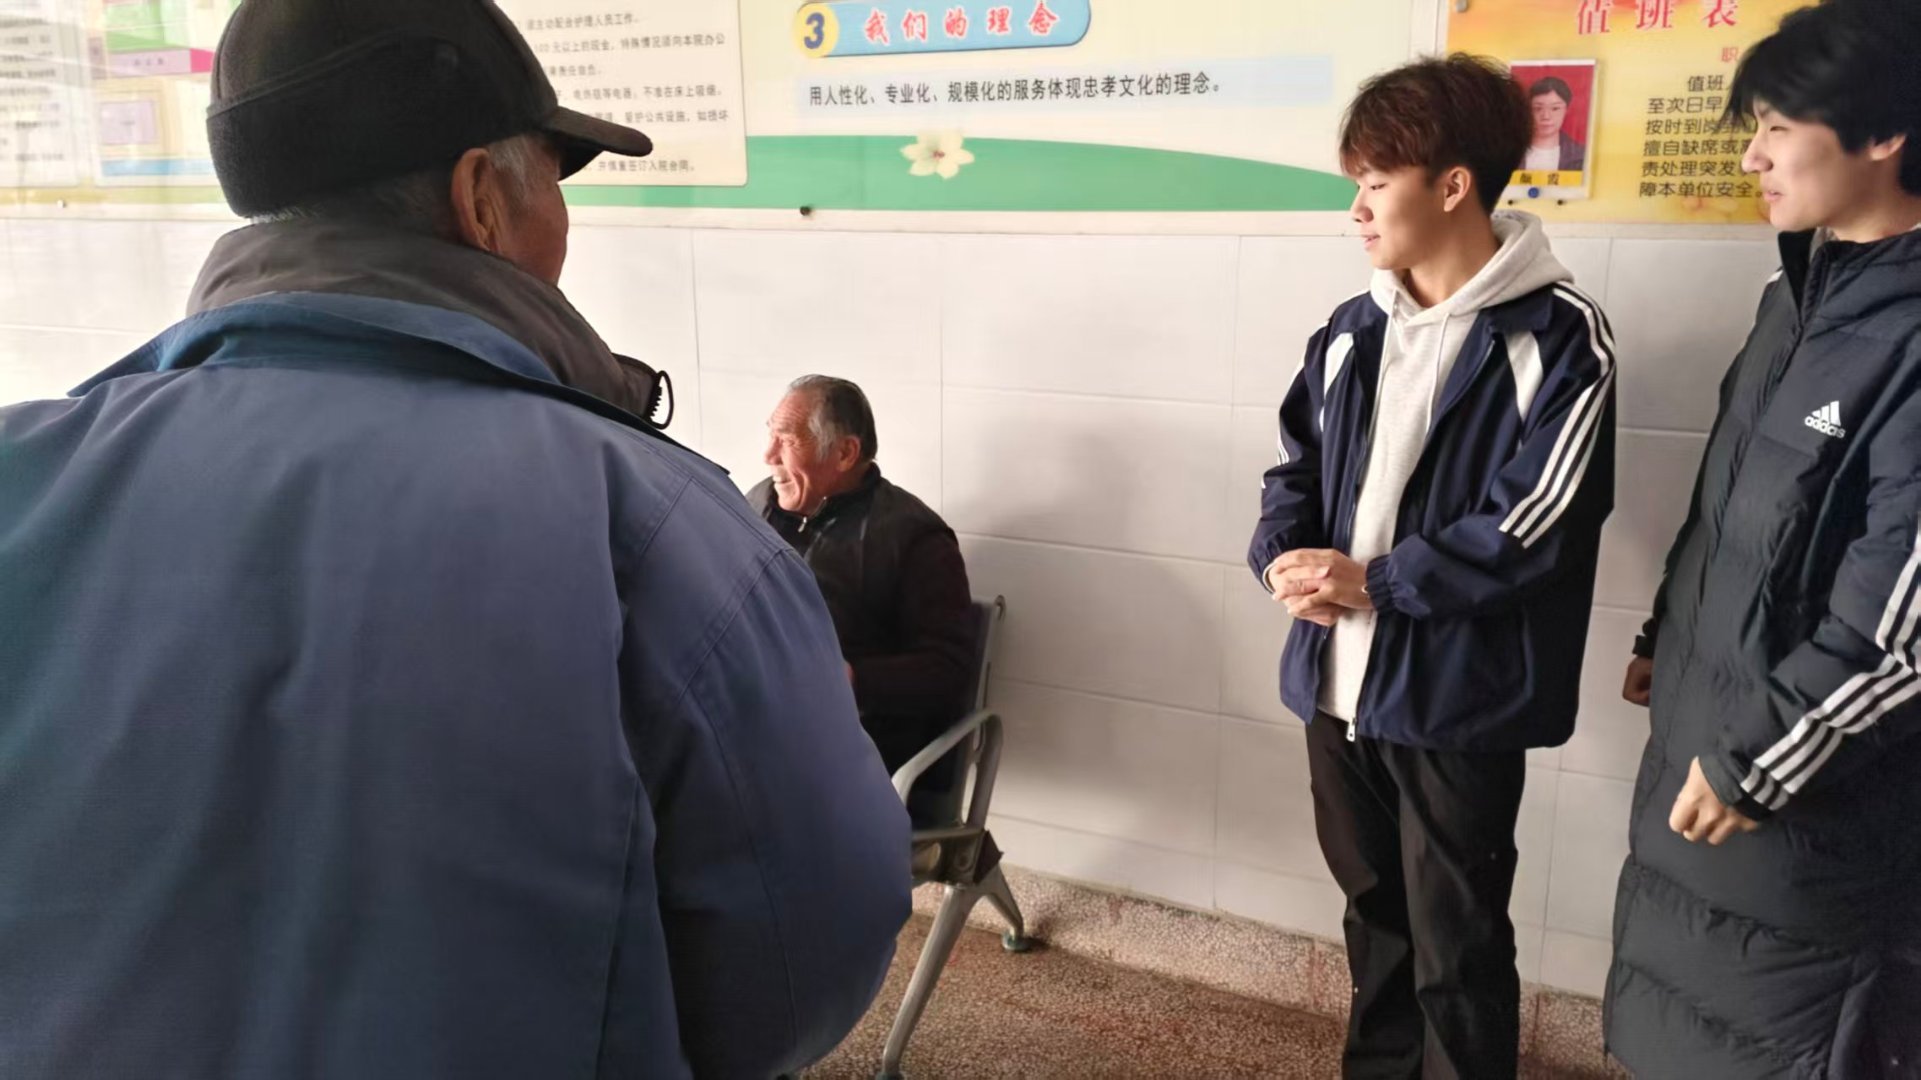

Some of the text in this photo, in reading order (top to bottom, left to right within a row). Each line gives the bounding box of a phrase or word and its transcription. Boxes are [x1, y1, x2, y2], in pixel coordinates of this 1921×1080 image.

[803, 3, 1059, 50] 3 我们的理念
[1687, 75, 1730, 92] 值班
[1804, 415, 1846, 438] adidas
